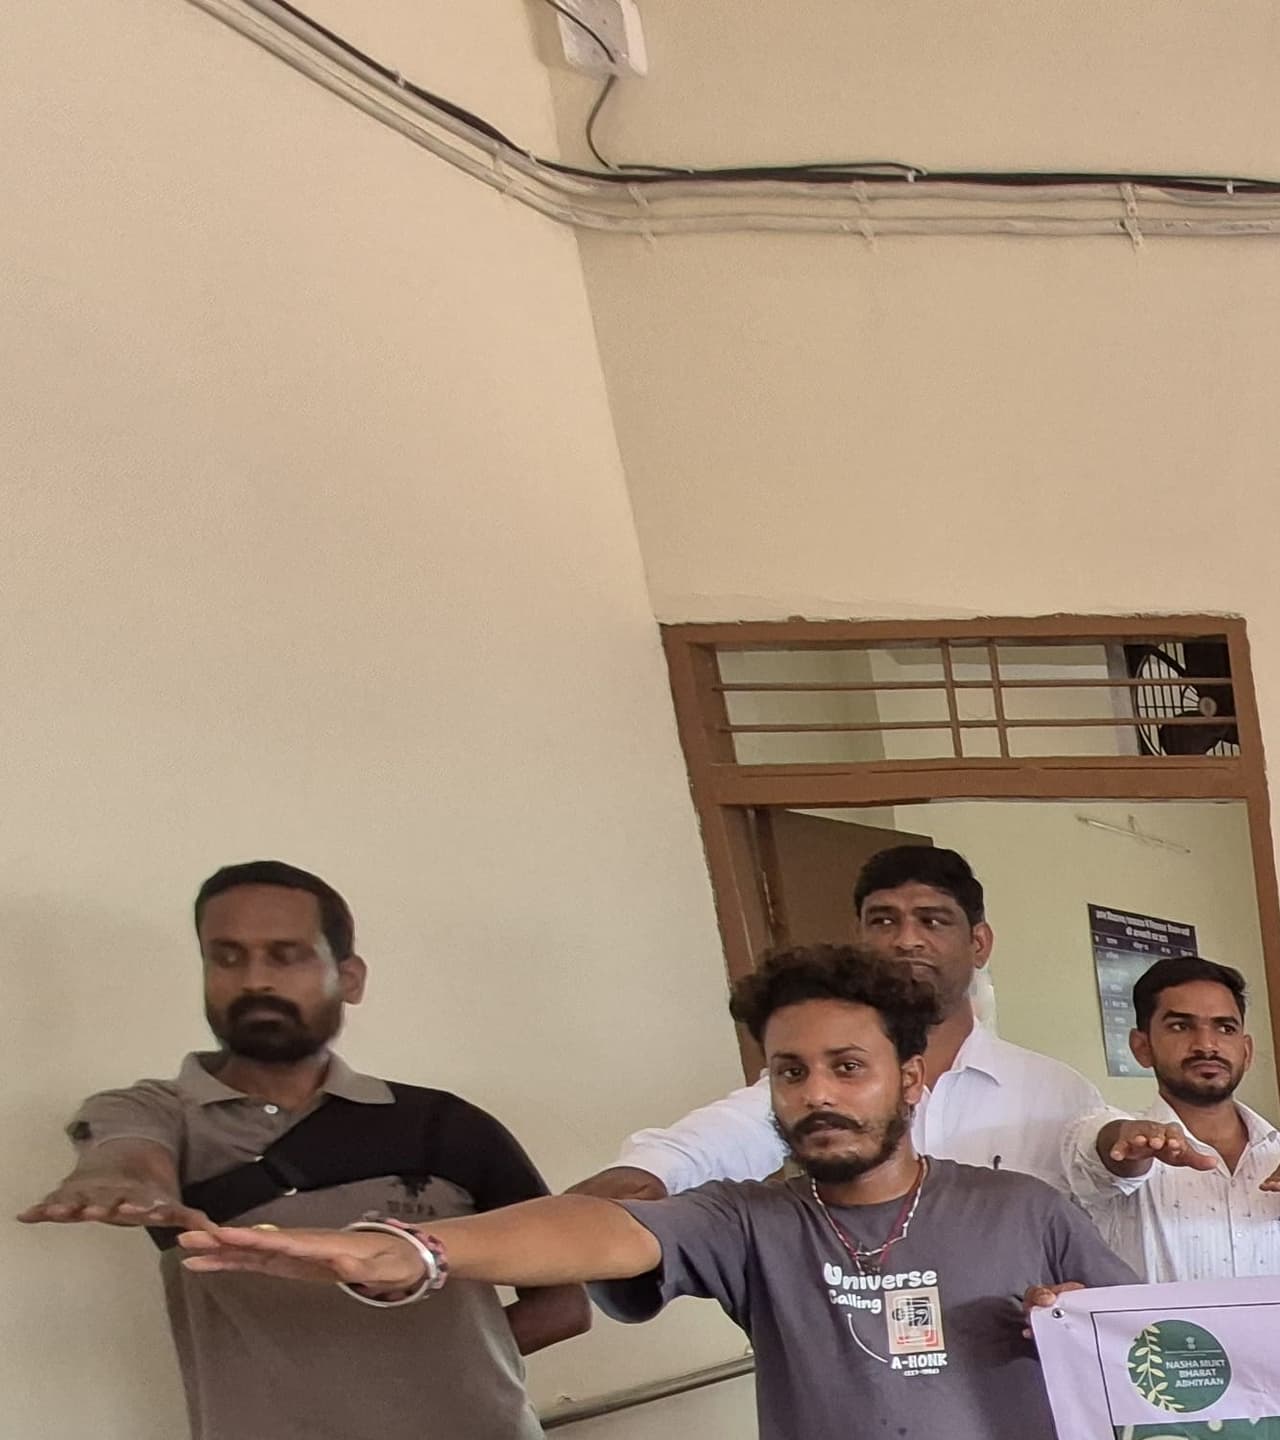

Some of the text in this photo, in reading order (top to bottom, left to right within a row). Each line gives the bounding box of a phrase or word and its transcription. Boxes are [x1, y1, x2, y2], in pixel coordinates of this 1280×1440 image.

[823, 1262, 938, 1291] Universe
[828, 1289, 883, 1314] Calling
[1166, 1359, 1225, 1369] NASHA MUKT
[1178, 1368, 1217, 1378] BHARAT
[1175, 1378, 1224, 1388] ABHIYAAN
